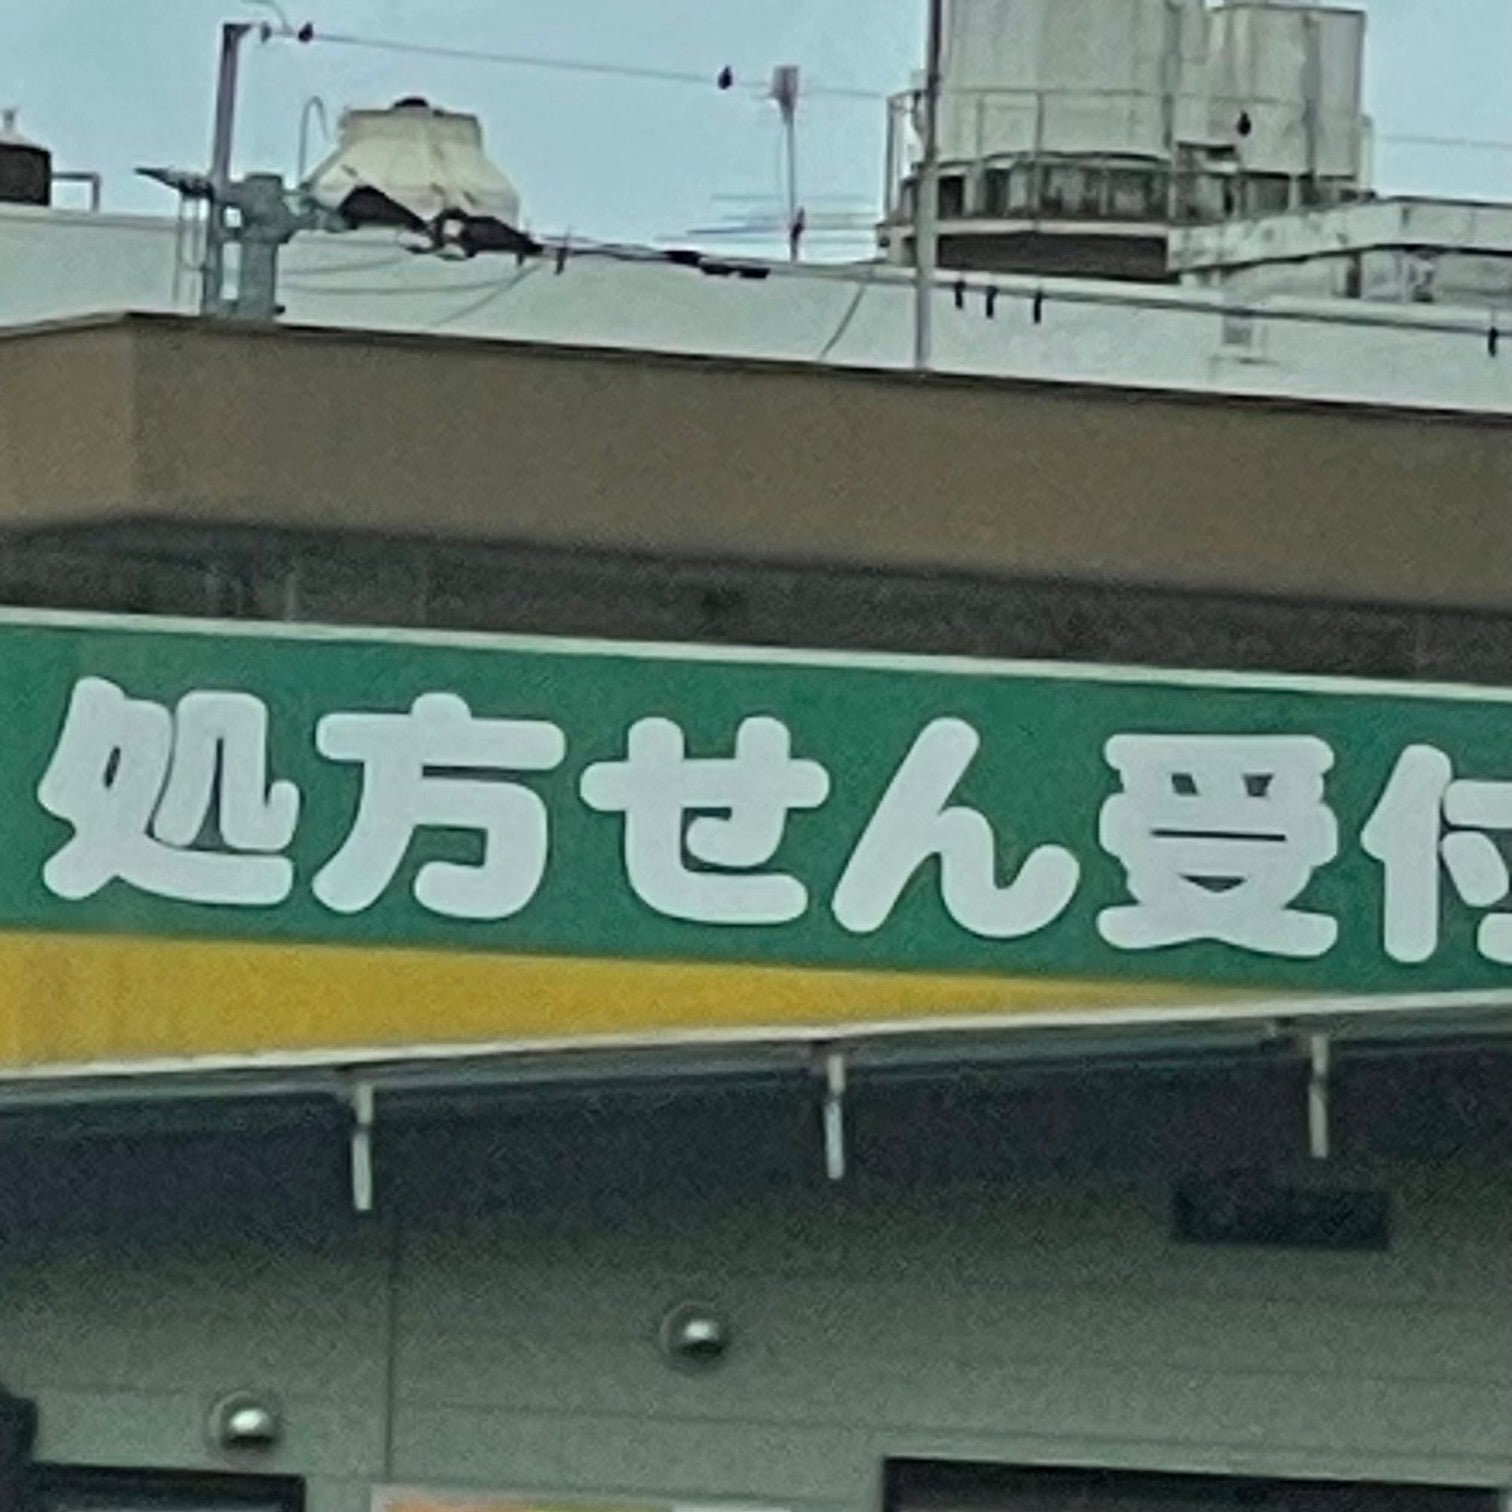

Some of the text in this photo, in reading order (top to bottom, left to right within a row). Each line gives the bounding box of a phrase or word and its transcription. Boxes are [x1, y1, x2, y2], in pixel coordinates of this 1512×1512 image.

[38, 675, 1512, 964] 処方せん受付
